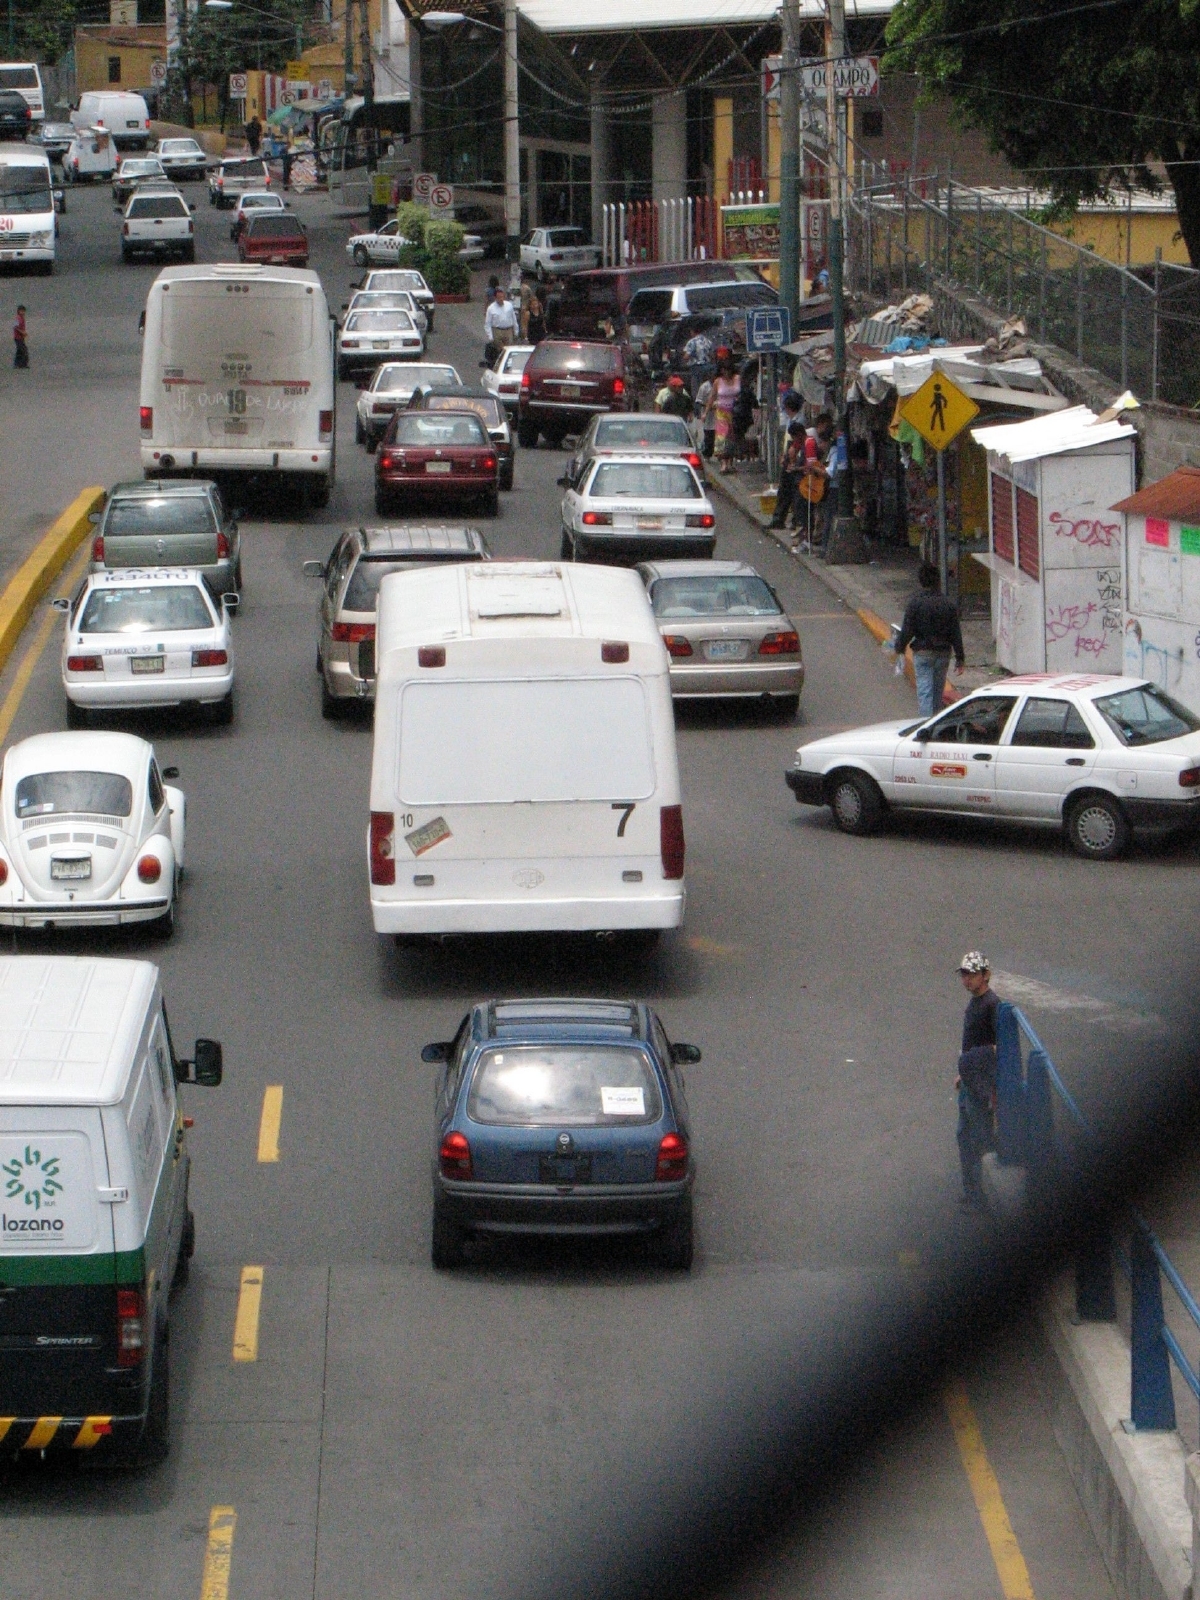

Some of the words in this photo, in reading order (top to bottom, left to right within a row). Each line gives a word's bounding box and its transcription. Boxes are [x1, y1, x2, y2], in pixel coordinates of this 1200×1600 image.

[909, 750, 923, 759] TAXI
[930, 751, 951, 759] RADIO
[953, 752, 969, 760] TAXI
[400, 813, 414, 828] 10
[611, 803, 636, 837] 7
[3, 1213, 64, 1231] lozano
